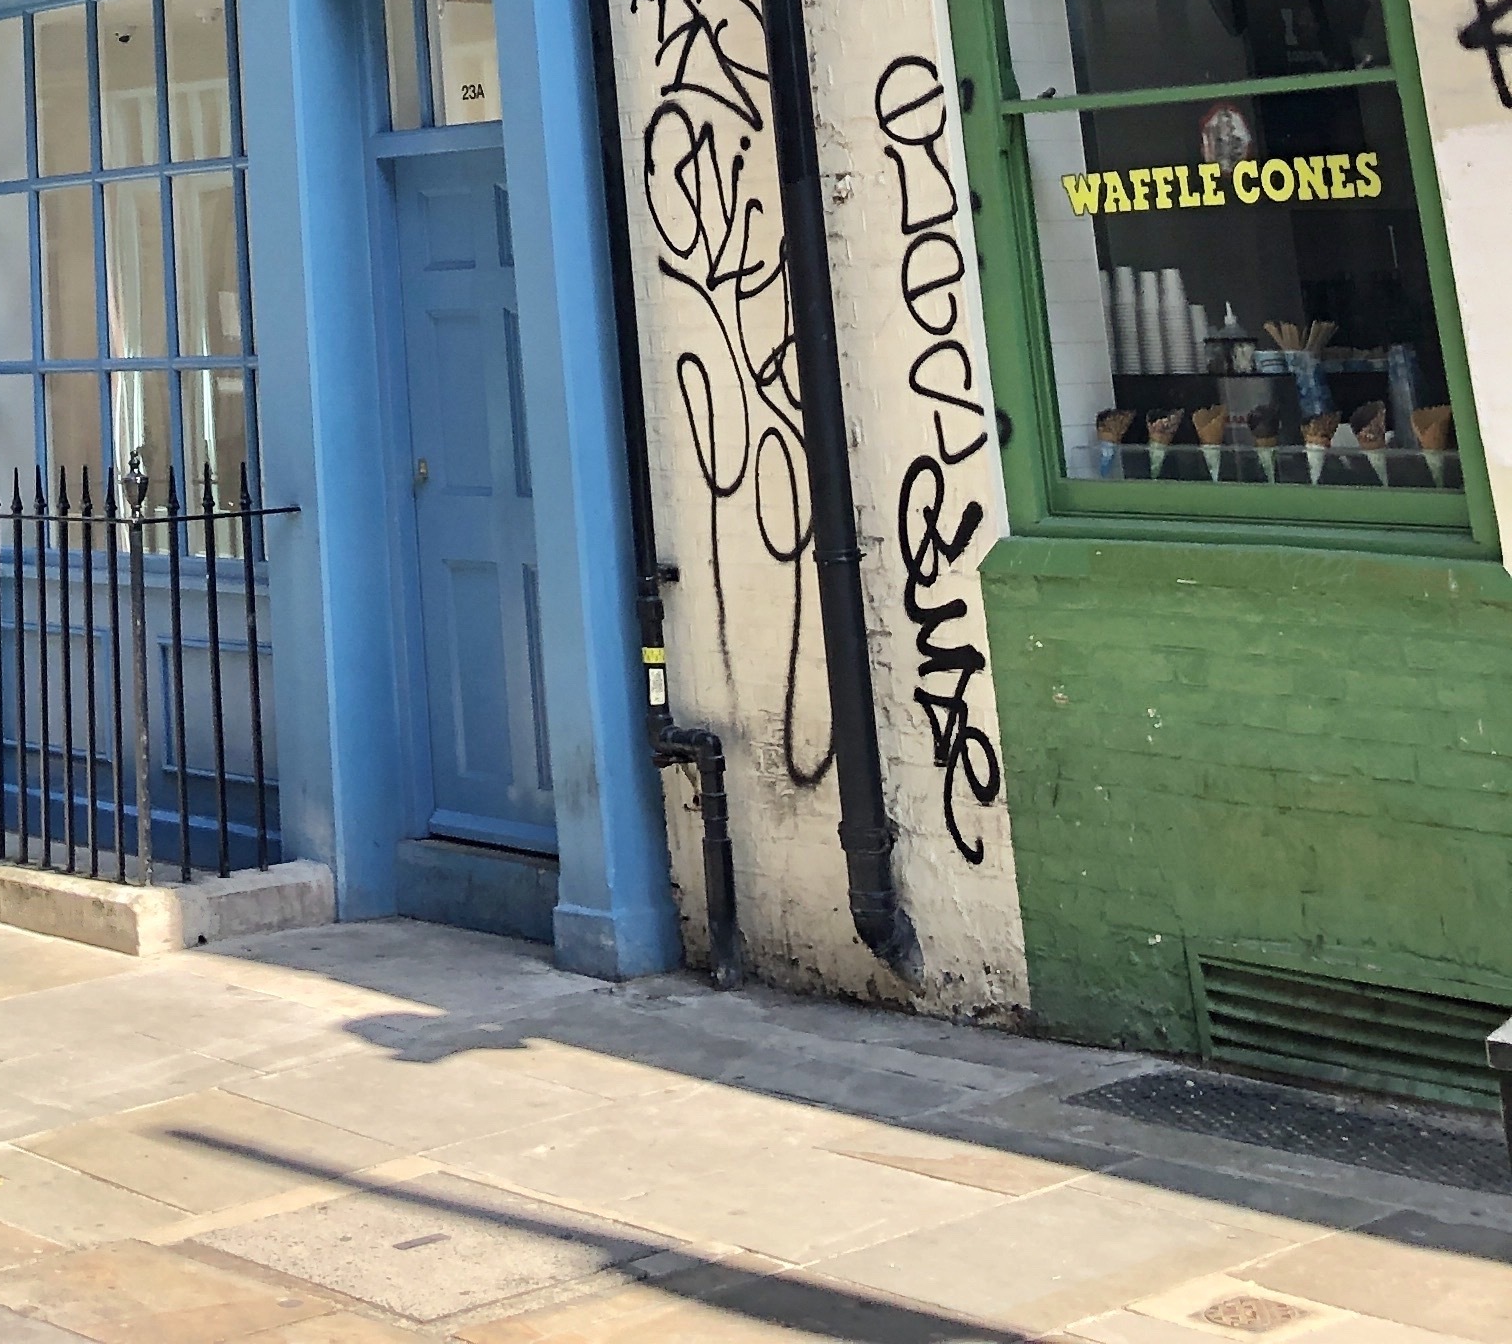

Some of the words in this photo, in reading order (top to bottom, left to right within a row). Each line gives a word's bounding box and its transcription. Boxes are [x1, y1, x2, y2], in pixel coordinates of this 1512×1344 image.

[461, 83, 485, 101] 23A
[1061, 162, 1226, 216] WAFFLE
[1233, 152, 1382, 204] CONES
